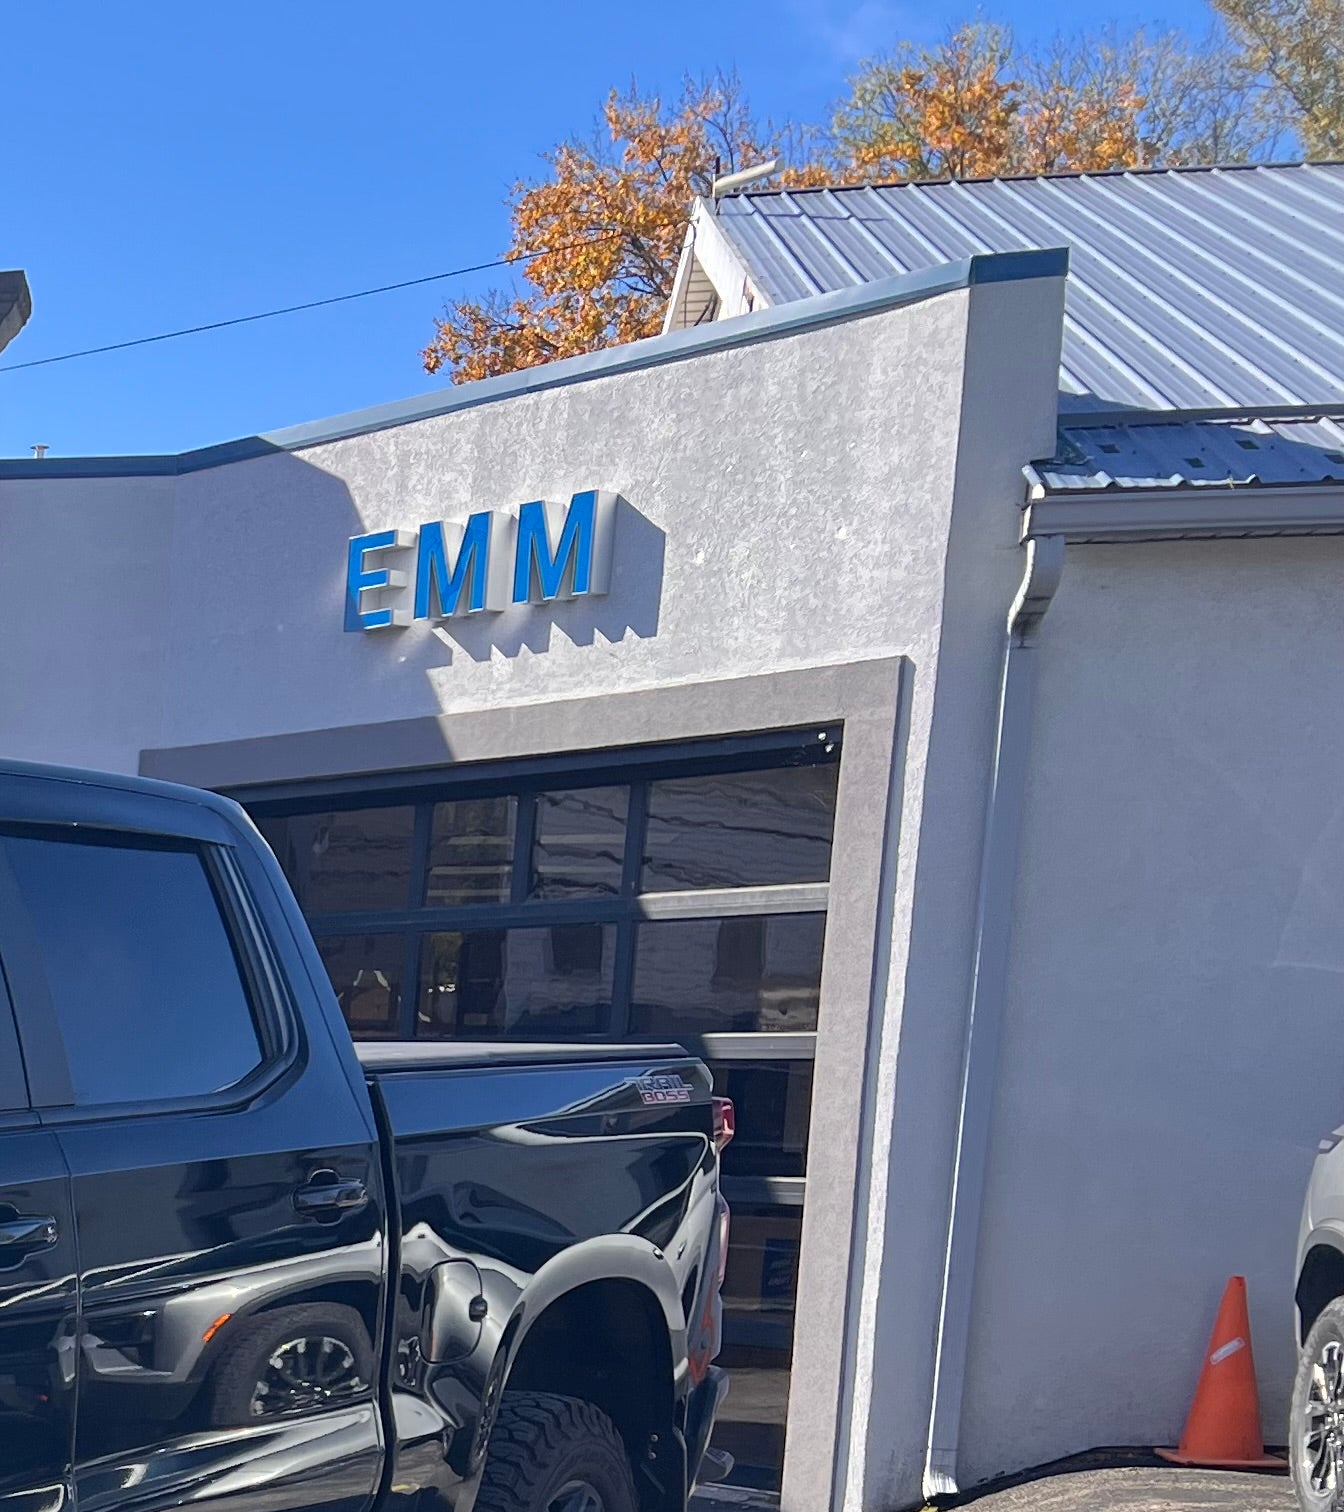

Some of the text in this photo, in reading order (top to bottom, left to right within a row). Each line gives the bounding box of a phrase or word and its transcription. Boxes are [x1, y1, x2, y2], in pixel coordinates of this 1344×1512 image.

[343, 489, 618, 632] EMM
[624, 1074, 694, 1092] TRAIL
[640, 1089, 691, 1105] BOSS
